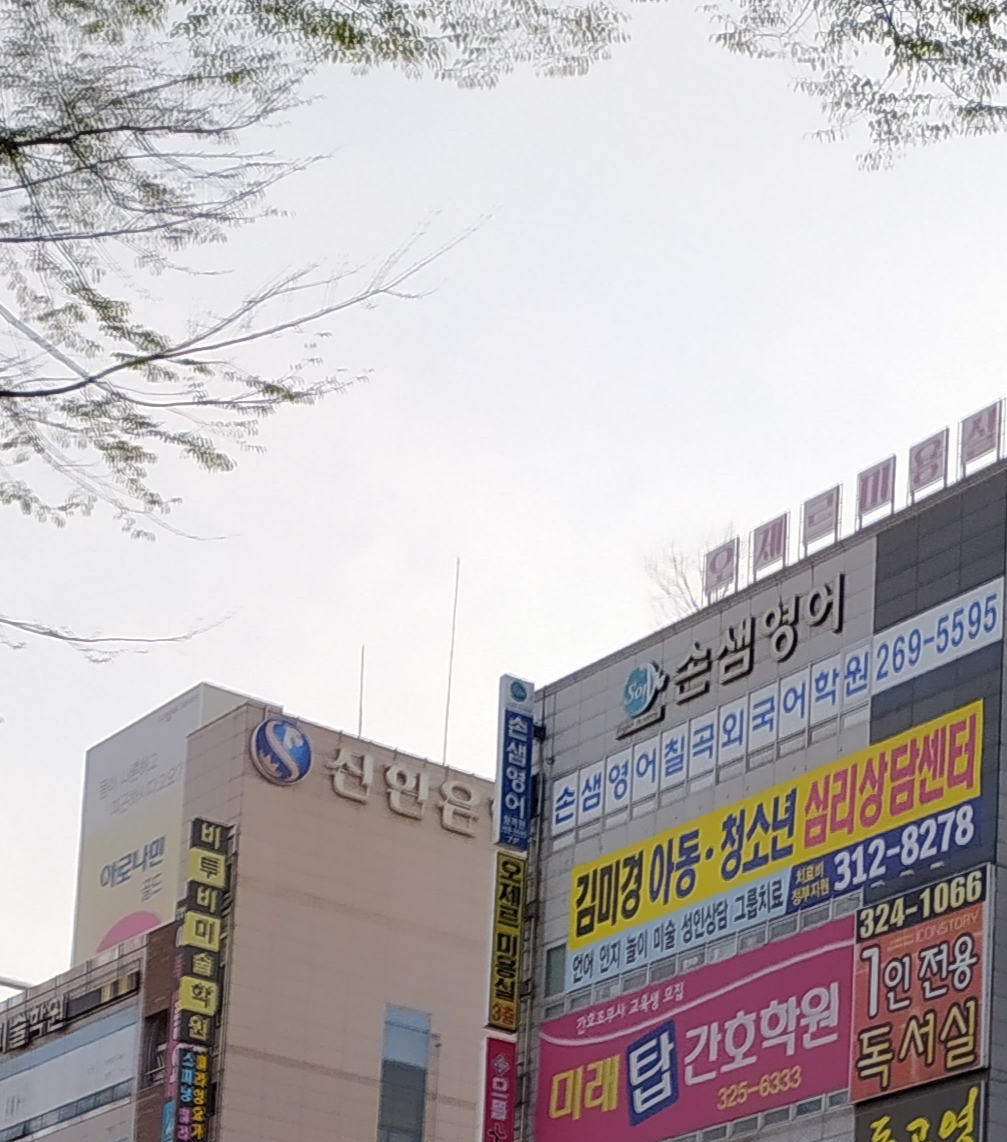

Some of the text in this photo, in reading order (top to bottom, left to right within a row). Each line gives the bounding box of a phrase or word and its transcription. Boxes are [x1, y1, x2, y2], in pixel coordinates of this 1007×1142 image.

[673, 573, 846, 703] 손샘영어
[875, 593, 999, 681] 269-5595
[329, 747, 481, 838] 신한은
[505, 715, 529, 818] 손샘영어
[100, 835, 165, 888] 아로나민
[575, 849, 643, 939] 김미경
[803, 713, 977, 849] 심리상담센터
[833, 804, 976, 892] 312-8278
[187, 822, 222, 1040] 비투비미술학원
[496, 860, 521, 1001] 오제르 미용실
[571, 955, 593, 984] 언어
[653, 928, 675, 956] 미술
[681, 909, 728, 945] 성인상담
[733, 880, 785, 920] 그룹치료
[860, 870, 983, 938] 324-1066
[576, 981, 685, 1036] 간호조무사 교육생 모집
[861, 930, 979, 1018] 1인 전용
[549, 981, 839, 1122] 미래 탑 간호학원
[857, 998, 977, 1087] 독서실
[717, 1065, 803, 1111] 325-6333
